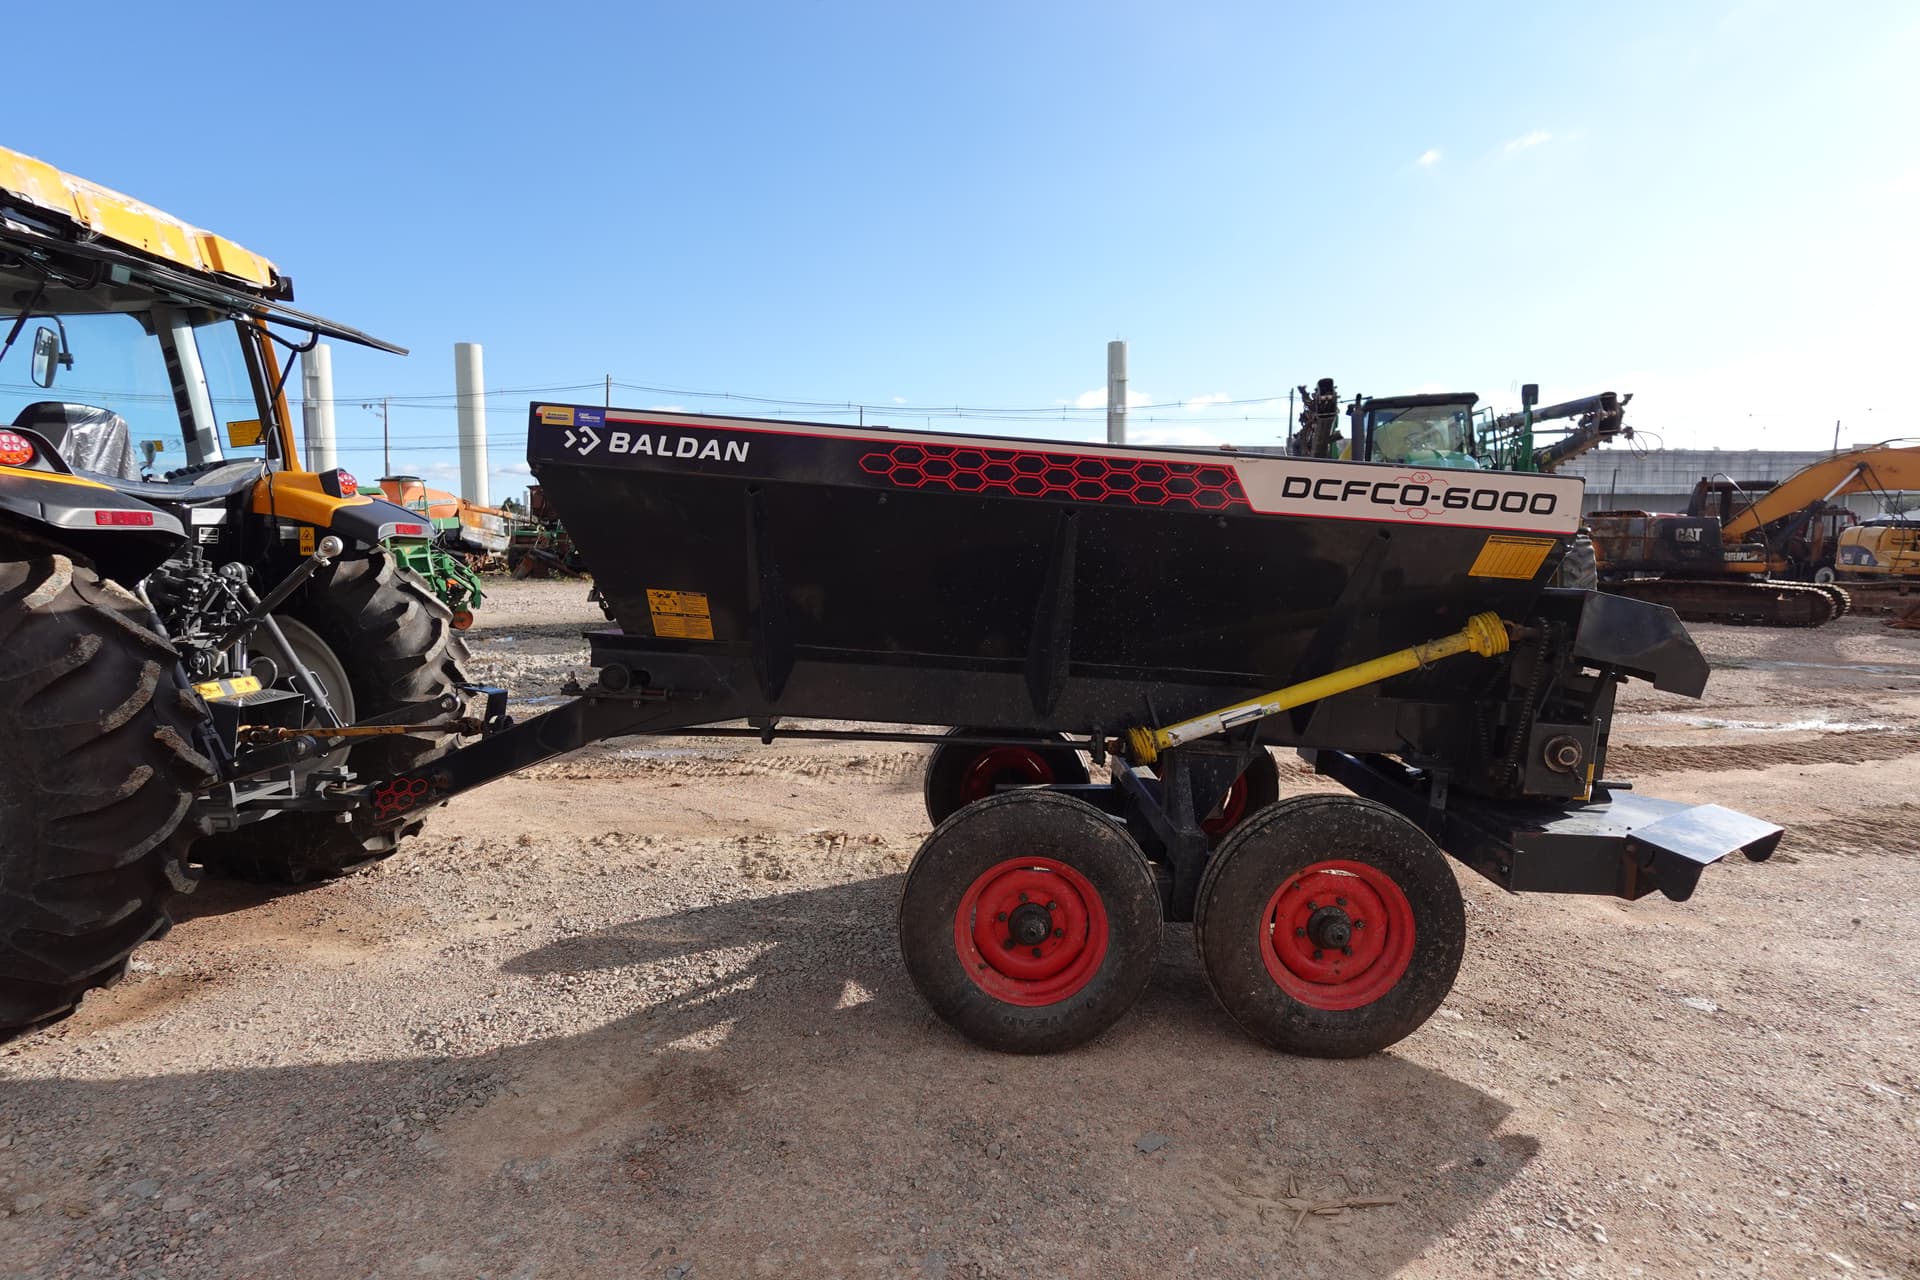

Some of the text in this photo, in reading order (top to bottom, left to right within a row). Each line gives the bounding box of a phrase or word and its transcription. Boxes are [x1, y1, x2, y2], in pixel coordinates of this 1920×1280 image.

[608, 431, 750, 462] BALDAN
[1281, 475, 1558, 515] DCFCO-6000
[1675, 528, 1703, 542] CAT
